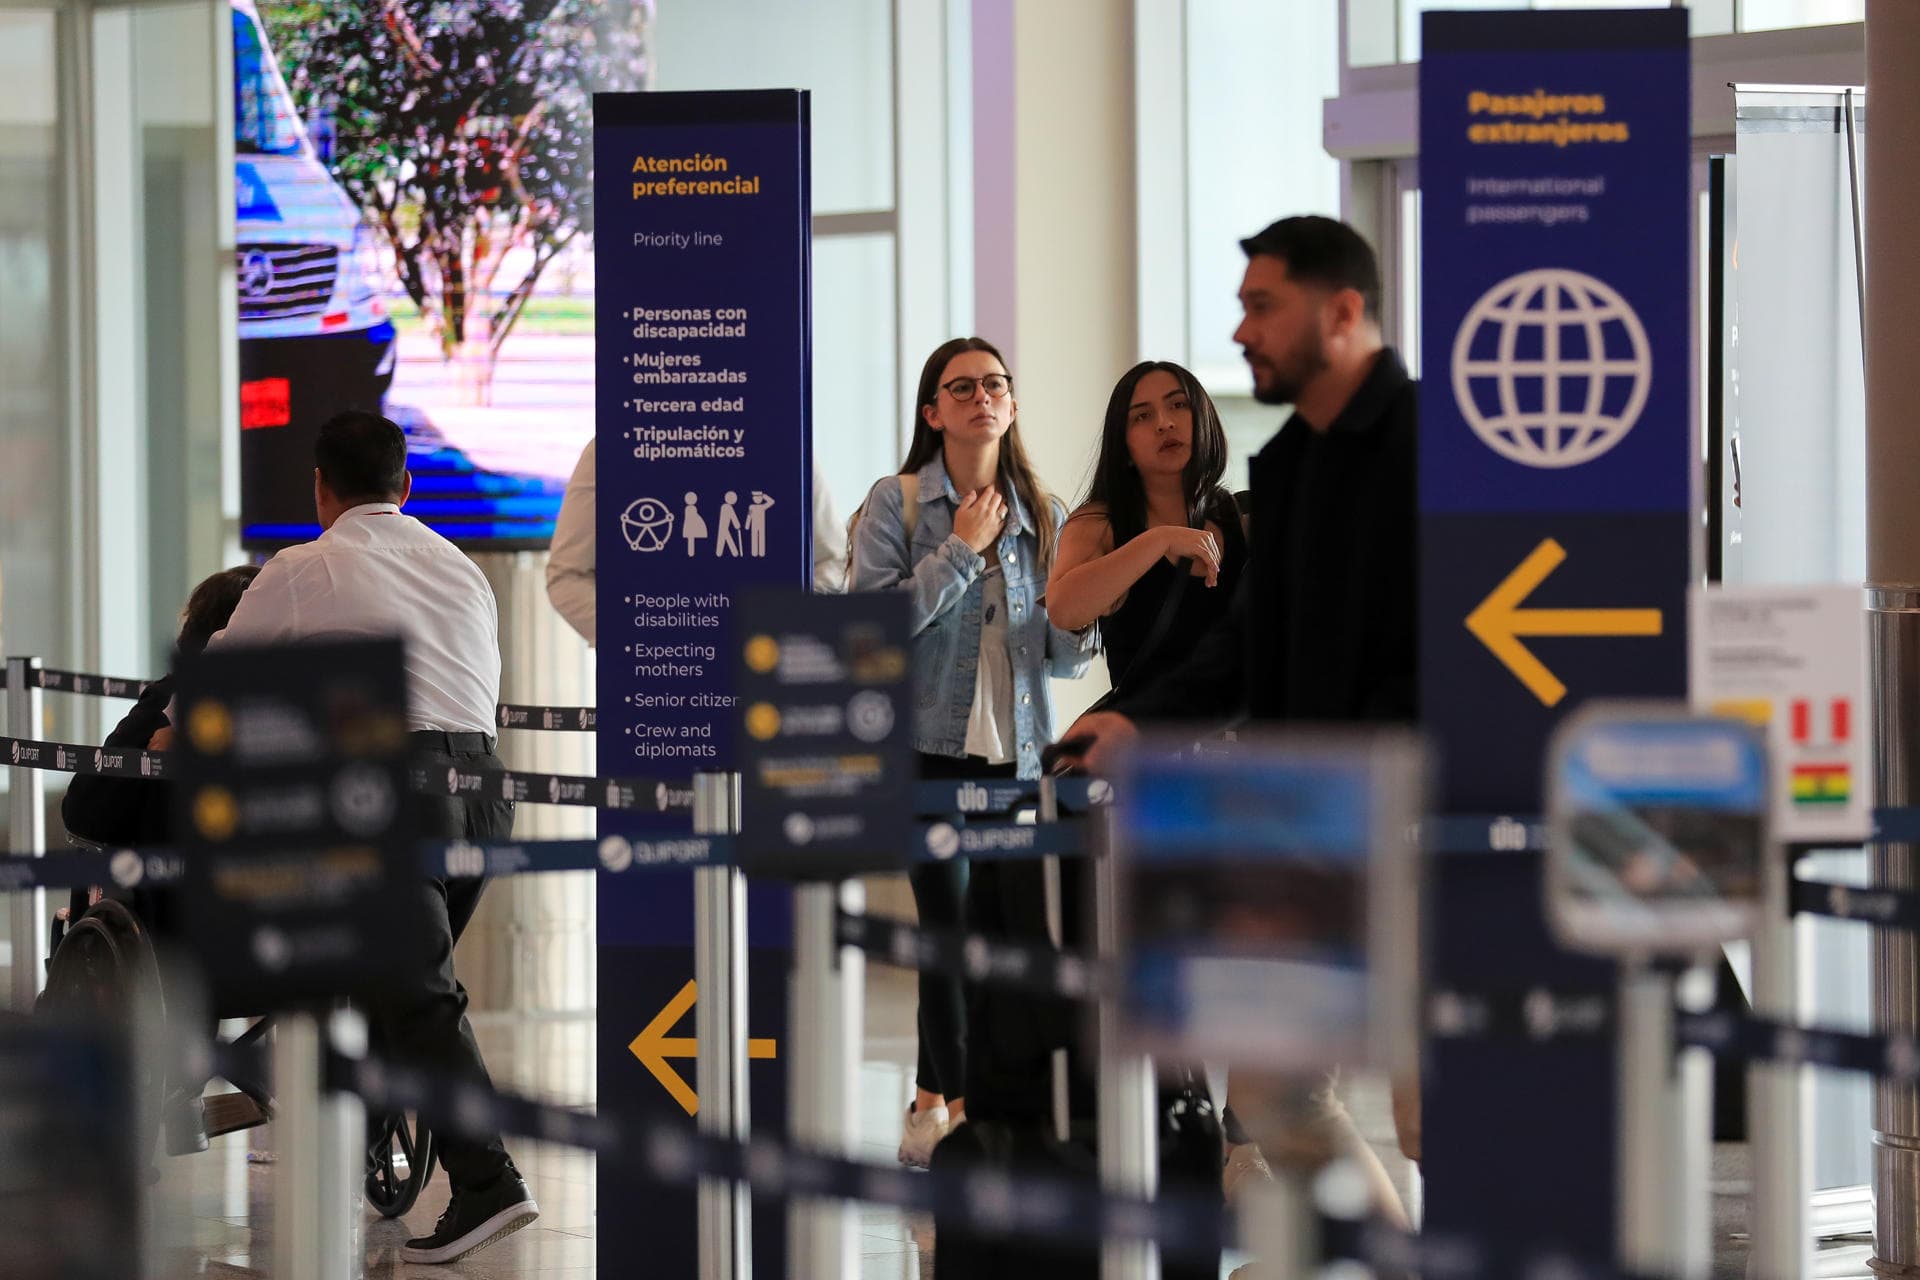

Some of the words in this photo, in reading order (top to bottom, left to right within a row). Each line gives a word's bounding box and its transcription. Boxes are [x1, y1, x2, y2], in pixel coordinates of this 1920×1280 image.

[1468, 89, 1605, 119] Pasajeros
[1467, 118, 1629, 147] extranjeros
[633, 153, 728, 172] Atención
[633, 176, 760, 200] preferencial
[1466, 176, 1605, 196] International
[1466, 205, 1589, 226] passengers
[634, 232, 691, 249] Priority
[694, 231, 723, 246] line
[633, 308, 711, 324] Personas
[715, 308, 747, 321] con
[633, 323, 746, 340] discapacidad
[633, 352, 701, 369] Mujeres
[633, 368, 747, 384] embarazadas
[633, 398, 696, 413] Tercera
[701, 397, 744, 412] edad
[633, 425, 730, 444] Tripulación
[734, 429, 744, 444] y
[633, 442, 745, 461] diplomáticos
[635, 594, 690, 611] People
[694, 593, 730, 608] with
[634, 613, 720, 627] disabilities
[635, 643, 715, 660] Expecting
[635, 662, 703, 677] mothers
[634, 693, 686, 707] Senior
[634, 723, 676, 738] Crew
[680, 723, 711, 738] and
[635, 742, 716, 760] diplomats
